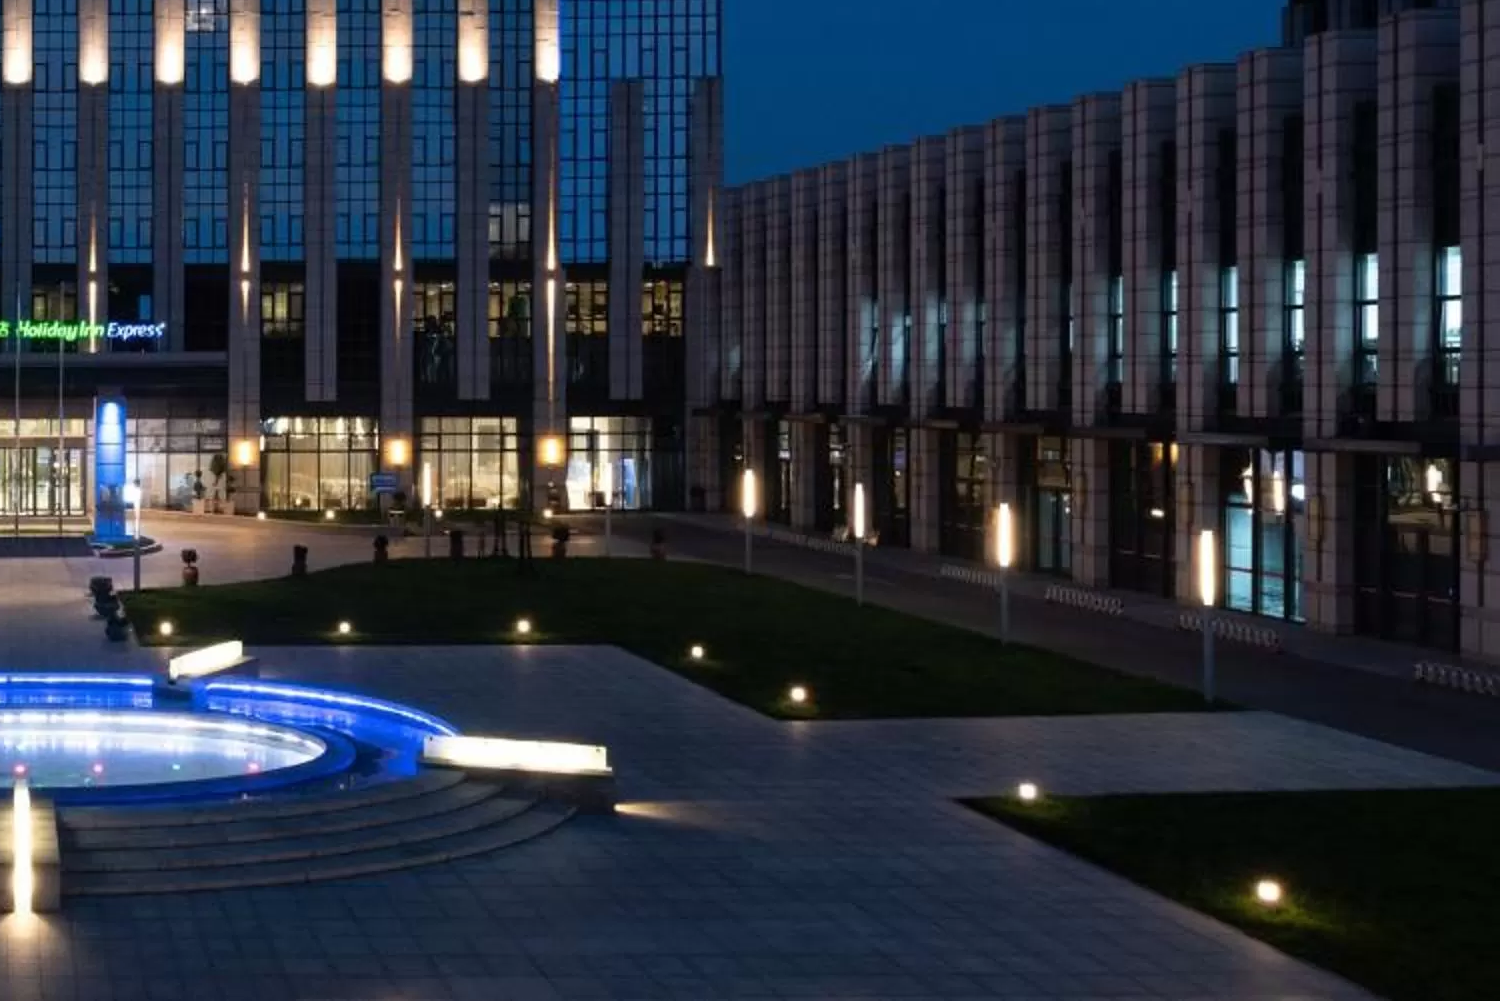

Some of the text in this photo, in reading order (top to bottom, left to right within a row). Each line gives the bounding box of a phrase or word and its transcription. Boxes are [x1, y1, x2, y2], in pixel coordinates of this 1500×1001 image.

[18, 320, 166, 341] Holiday Inn Express
